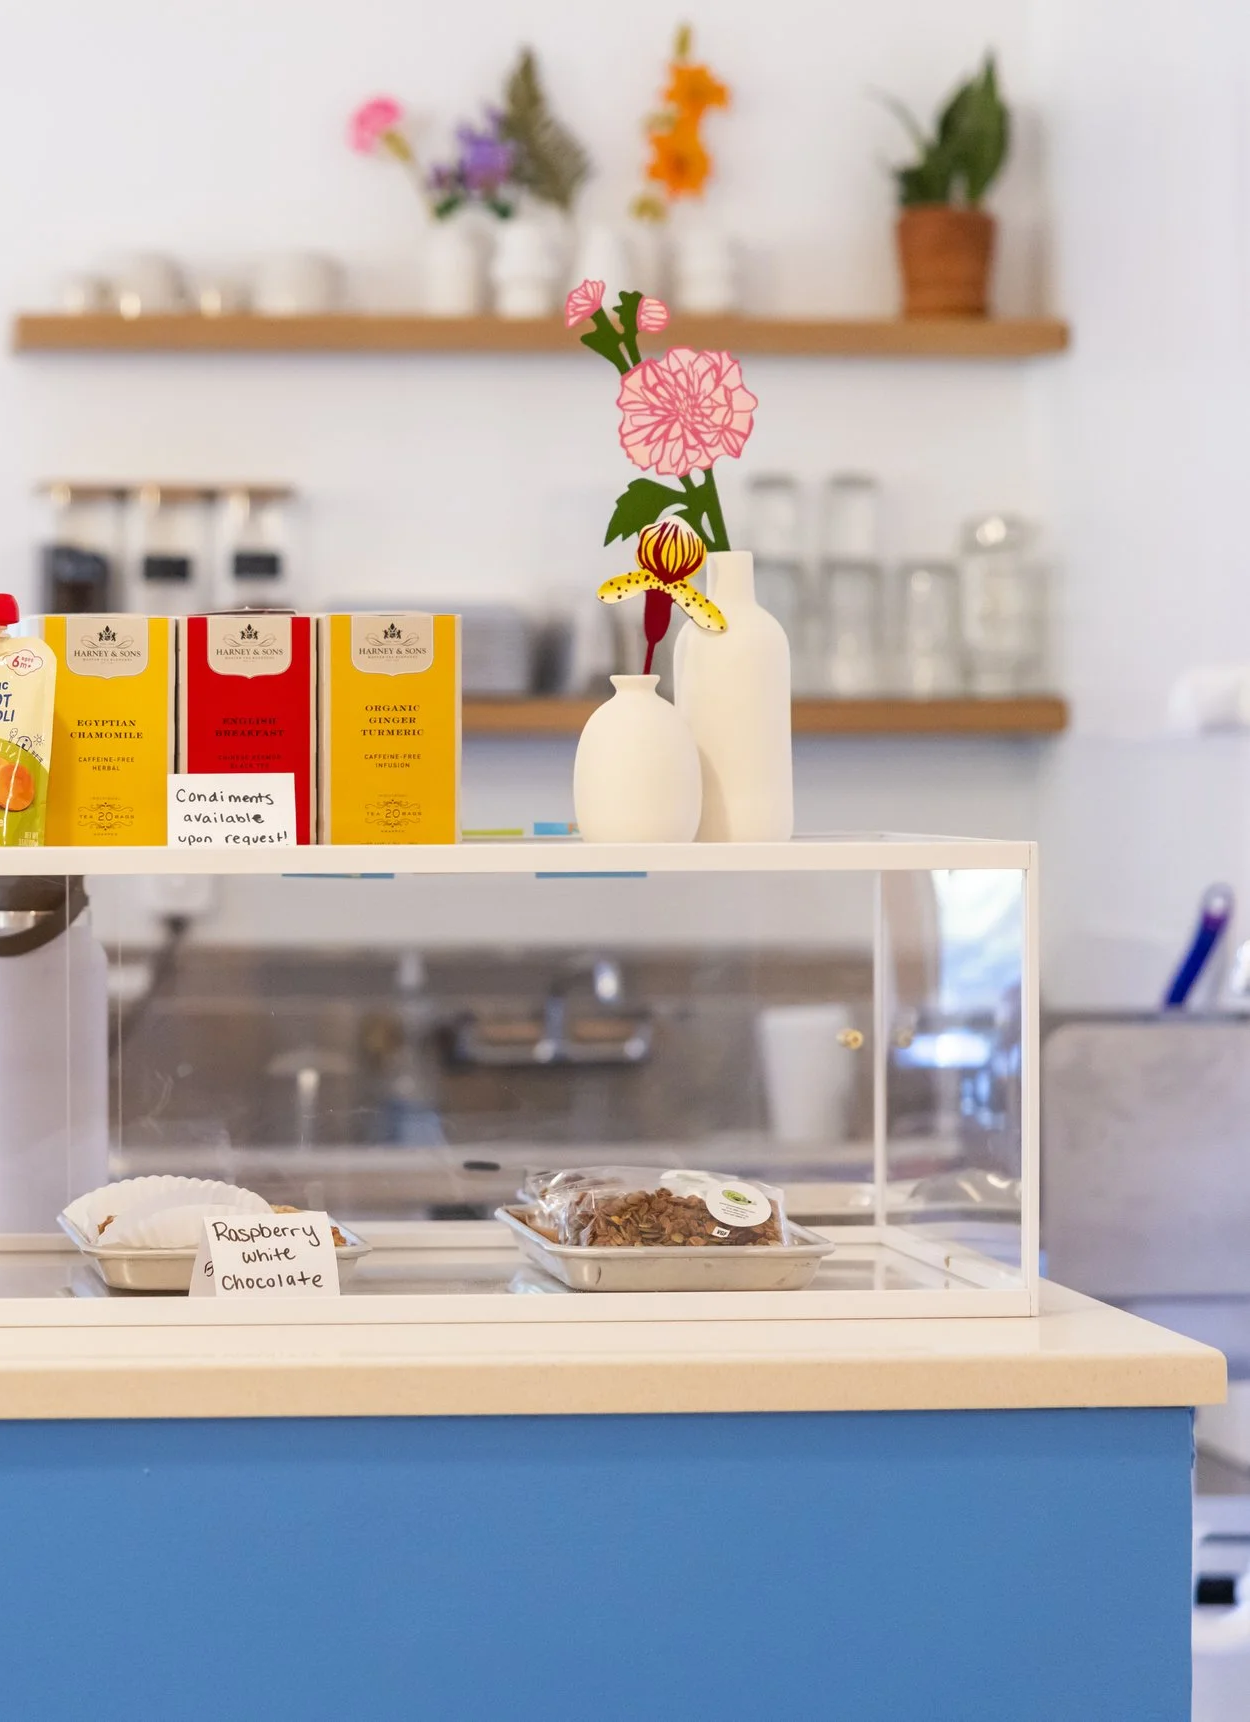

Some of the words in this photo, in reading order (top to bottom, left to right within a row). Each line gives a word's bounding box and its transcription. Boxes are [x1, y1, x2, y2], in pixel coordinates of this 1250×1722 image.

[74, 650, 109, 658] HARNEY
[110, 650, 118, 658] &
[119, 650, 142, 658] SONS
[215, 648, 251, 656] HARNEY
[252, 648, 260, 656] &
[261, 648, 284, 656] SONS
[358, 647, 395, 655] HARNEY
[396, 647, 403, 655] &
[404, 647, 428, 655] SONS
[11, 655, 20, 668] 6
[364, 704, 421, 712] ORGANIC
[76, 719, 137, 727] EGYPTIAN
[368, 716, 417, 725] GINGER
[69, 731, 144, 739] CHAMOMILE
[214, 729, 286, 738] BREAKFAST
[360, 728, 425, 737] TURMERIC
[176, 788, 275, 806] Condiments
[97, 811, 114, 822] 20
[183, 811, 265, 824] available
[385, 808, 401, 819] 20
[177, 834, 213, 846] upon
[224, 830, 288, 846] request!
[211, 1221, 321, 1247] Raspberry
[221, 1271, 324, 1291] Chocolate
